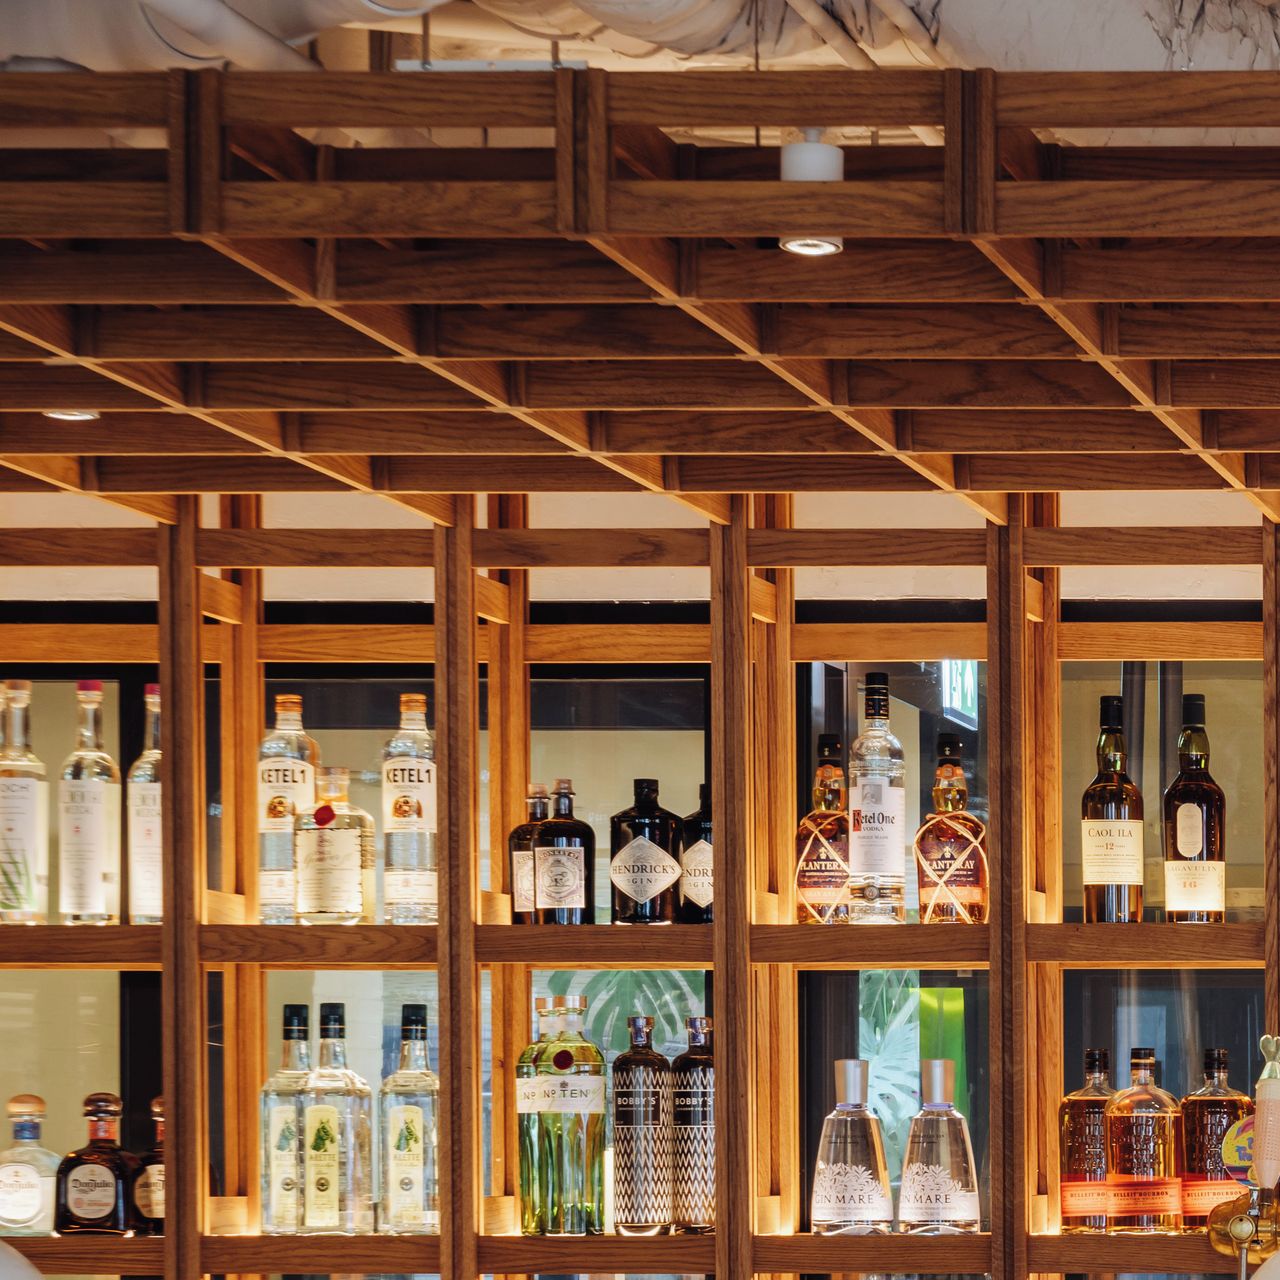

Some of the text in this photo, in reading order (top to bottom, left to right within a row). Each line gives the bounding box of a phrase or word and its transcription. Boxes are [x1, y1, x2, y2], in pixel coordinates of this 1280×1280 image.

[261, 768, 298, 783] KETEL
[386, 768, 424, 783] KETEL
[853, 810, 895, 831] Ketel One
[1088, 827, 1133, 838] CAOL ILA
[1105, 842, 1114, 850] 12
[611, 864, 676, 875] HENDRICK'S
[631, 877, 653, 885] GIN
[1182, 881, 1197, 889] 16
[559, 1089, 588, 1098] TEN
[617, 1096, 657, 1105] BOBBY'S
[675, 1096, 714, 1105] BOBBY'S
[815, 1194, 874, 1204] GIN MARE
[913, 1194, 951, 1204] MARE
